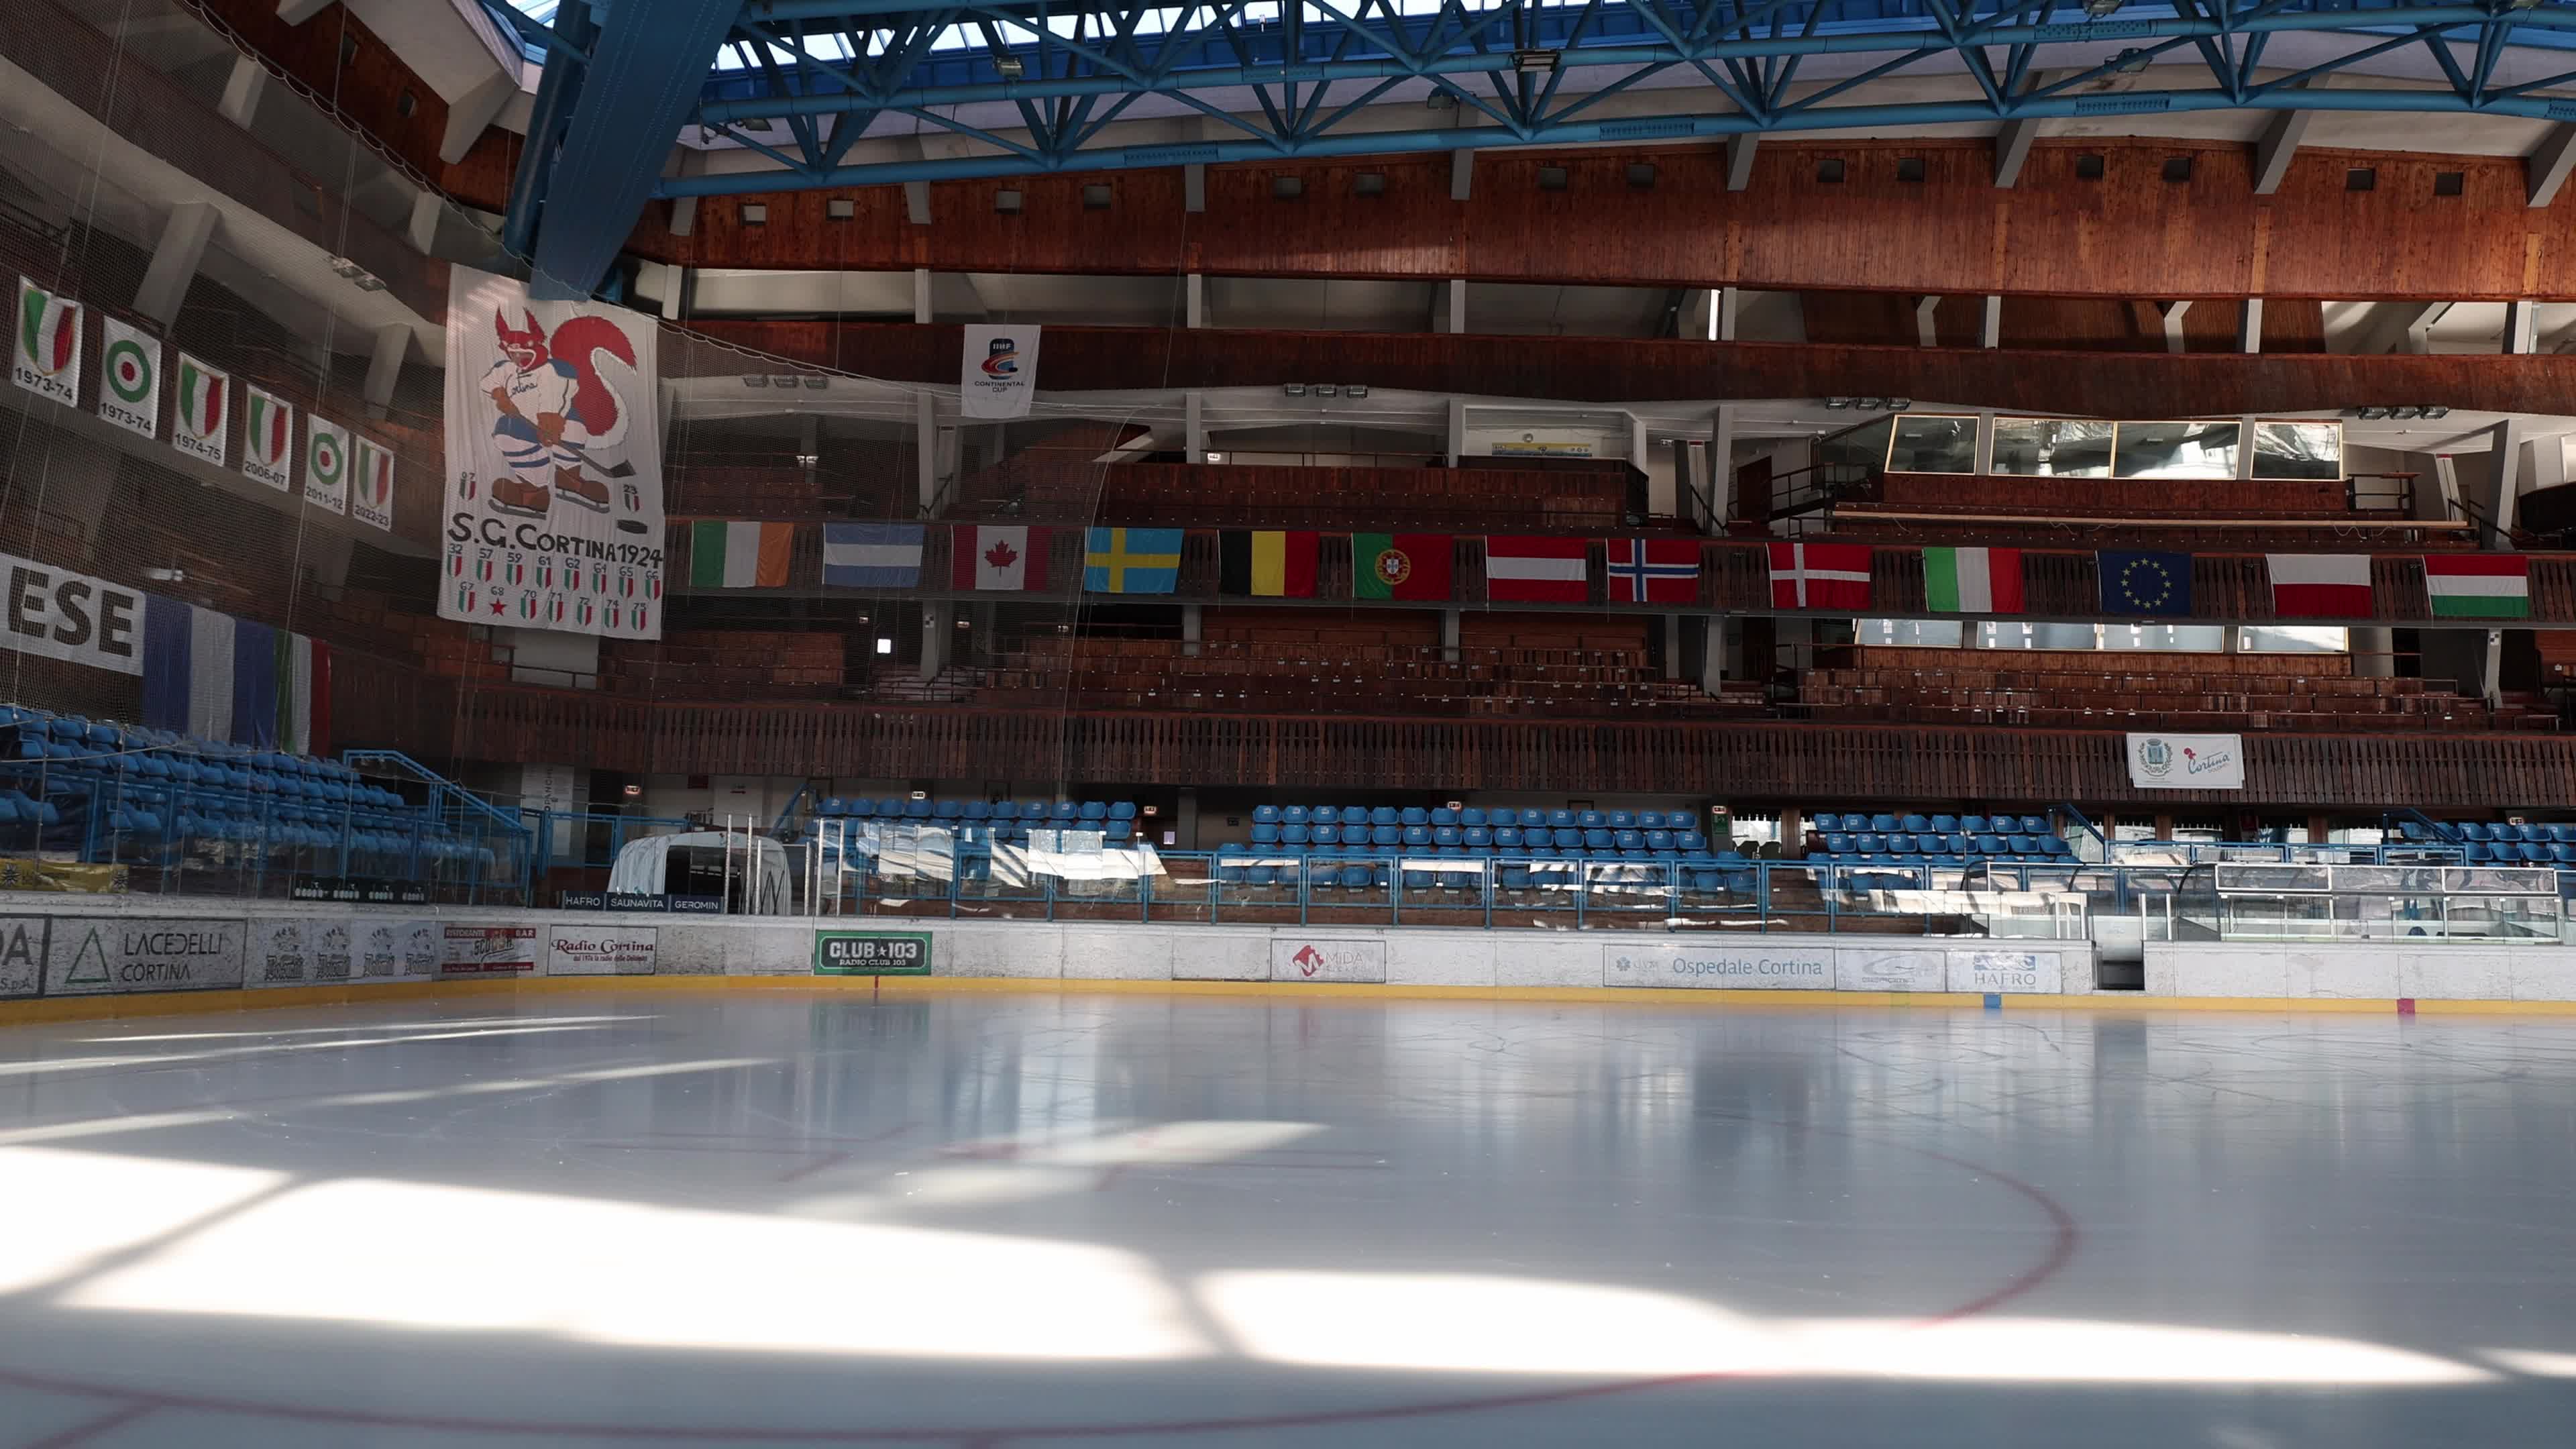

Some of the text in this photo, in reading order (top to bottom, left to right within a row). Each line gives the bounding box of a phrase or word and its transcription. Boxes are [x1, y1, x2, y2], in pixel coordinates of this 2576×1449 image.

[15, 367, 73, 400] 1973-74
[101, 402, 152, 431] 1973-74
[175, 433, 221, 460] 1974-75
[244, 461, 286, 485] 2006-07
[306, 486, 343, 511] 2011-12
[623, 484, 637, 494] 23
[355, 504, 389, 527] 2022-23
[449, 543, 463, 554] 32
[479, 548, 493, 559] 57
[507, 552, 523, 563] 59
[538, 556, 551, 566] 61
[565, 557, 580, 569] 62
[619, 566, 634, 577] 65
[645, 570, 659, 580] 66
[460, 581, 475, 591] 67
[490, 586, 504, 596] 68
[524, 590, 537, 598] 70
[579, 596, 590, 606] 72
[606, 599, 619, 608] 74
[2188, 751, 2231, 775] Cortina
[566, 896, 600, 906] HAFRO
[610, 898, 664, 908] SAUNAVITA
[675, 900, 718, 910] GEROMIN
[0, 923, 34, 966] A
[123, 932, 222, 956] LACEDELLI
[551, 939, 654, 955] Radio Cortina
[829, 942, 917, 959] CLUB 103
[121, 963, 191, 983] CORTINA
[1672, 957, 1752, 977] Ospedale
[1758, 959, 1823, 975] Cortina
[1974, 974, 2036, 985] HAFRO
